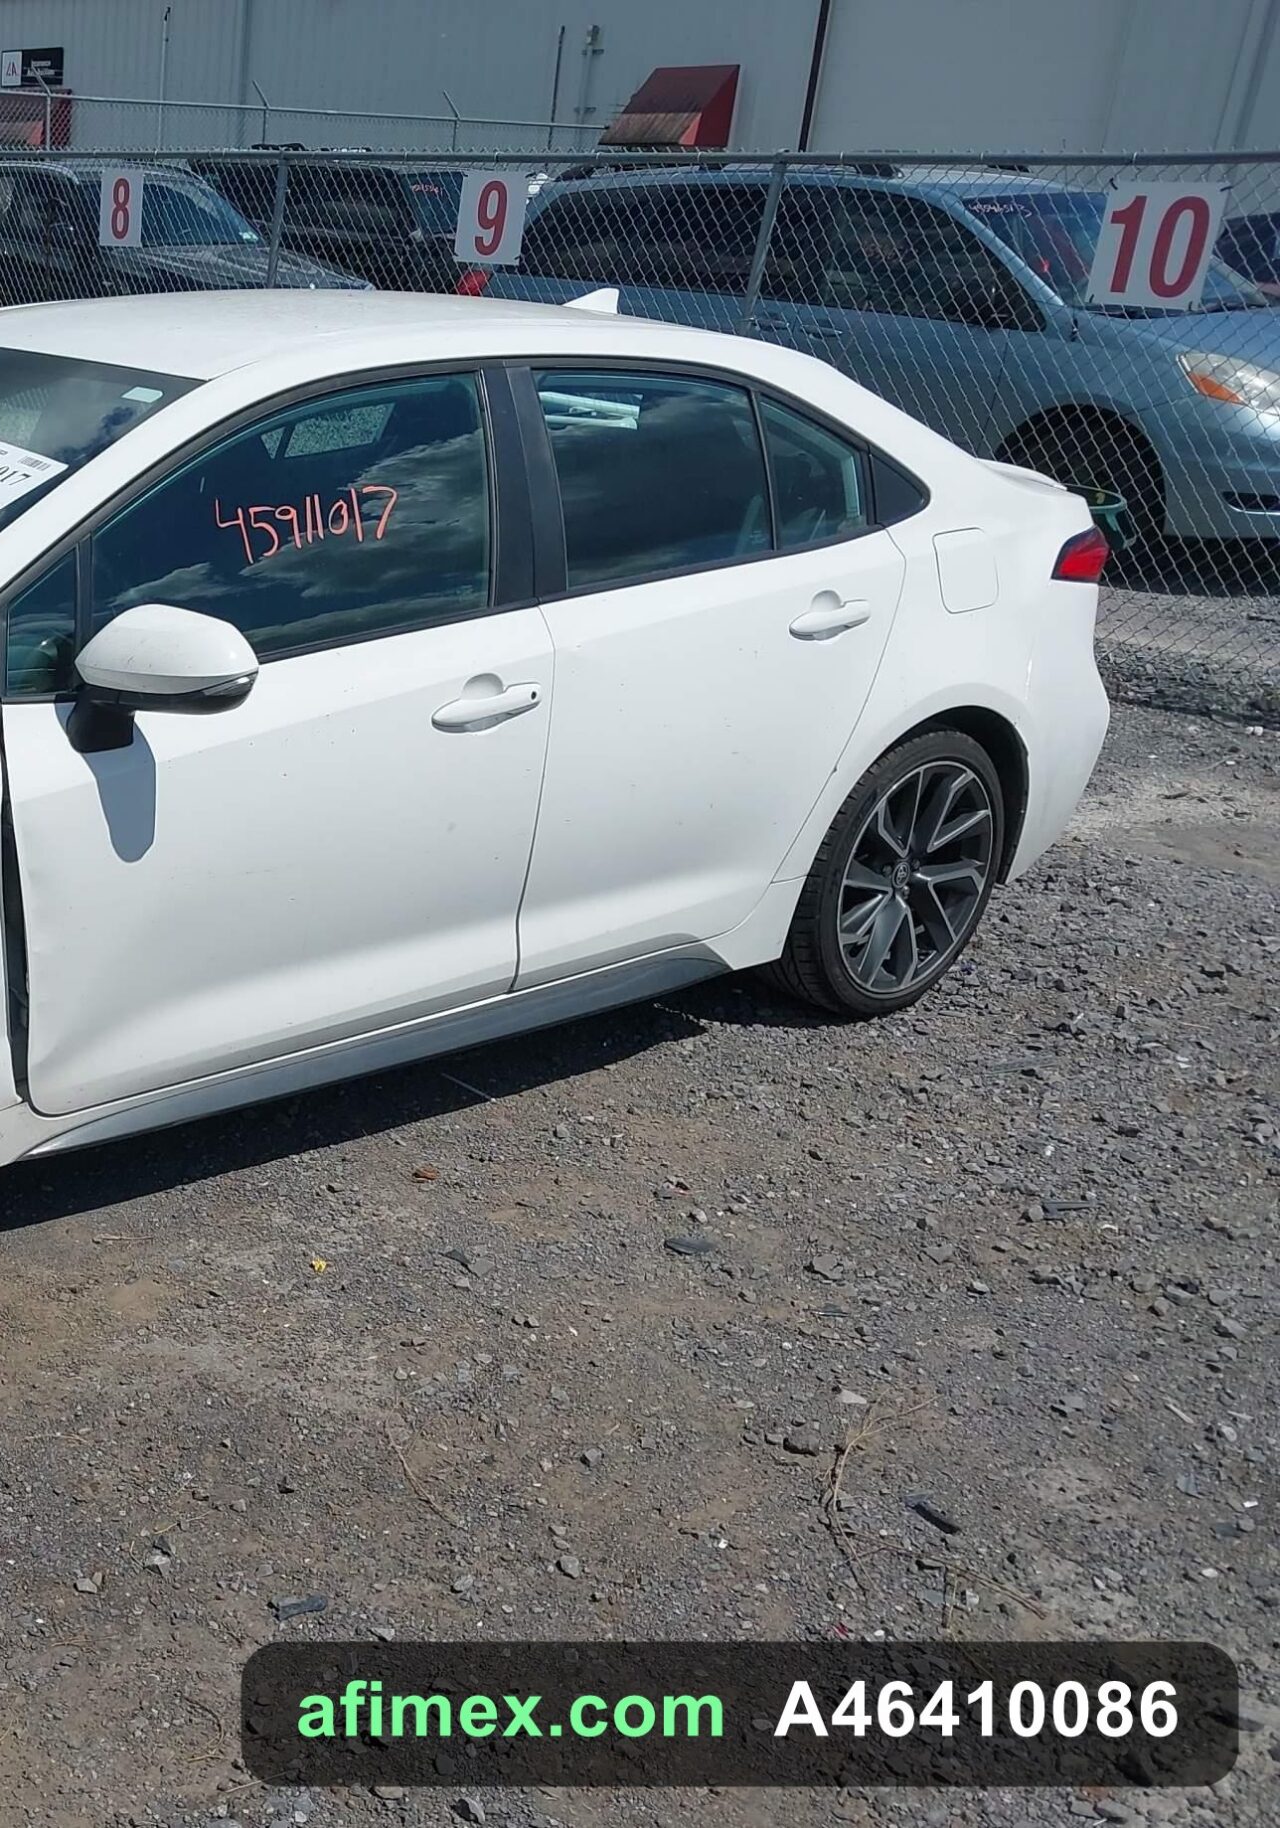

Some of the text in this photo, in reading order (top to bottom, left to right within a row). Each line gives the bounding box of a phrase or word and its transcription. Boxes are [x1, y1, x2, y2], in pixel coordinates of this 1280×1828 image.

[111, 177, 130, 240] 8
[474, 180, 508, 256] 9
[1109, 194, 1211, 298] 10
[215, 485, 398, 564] 45911017
